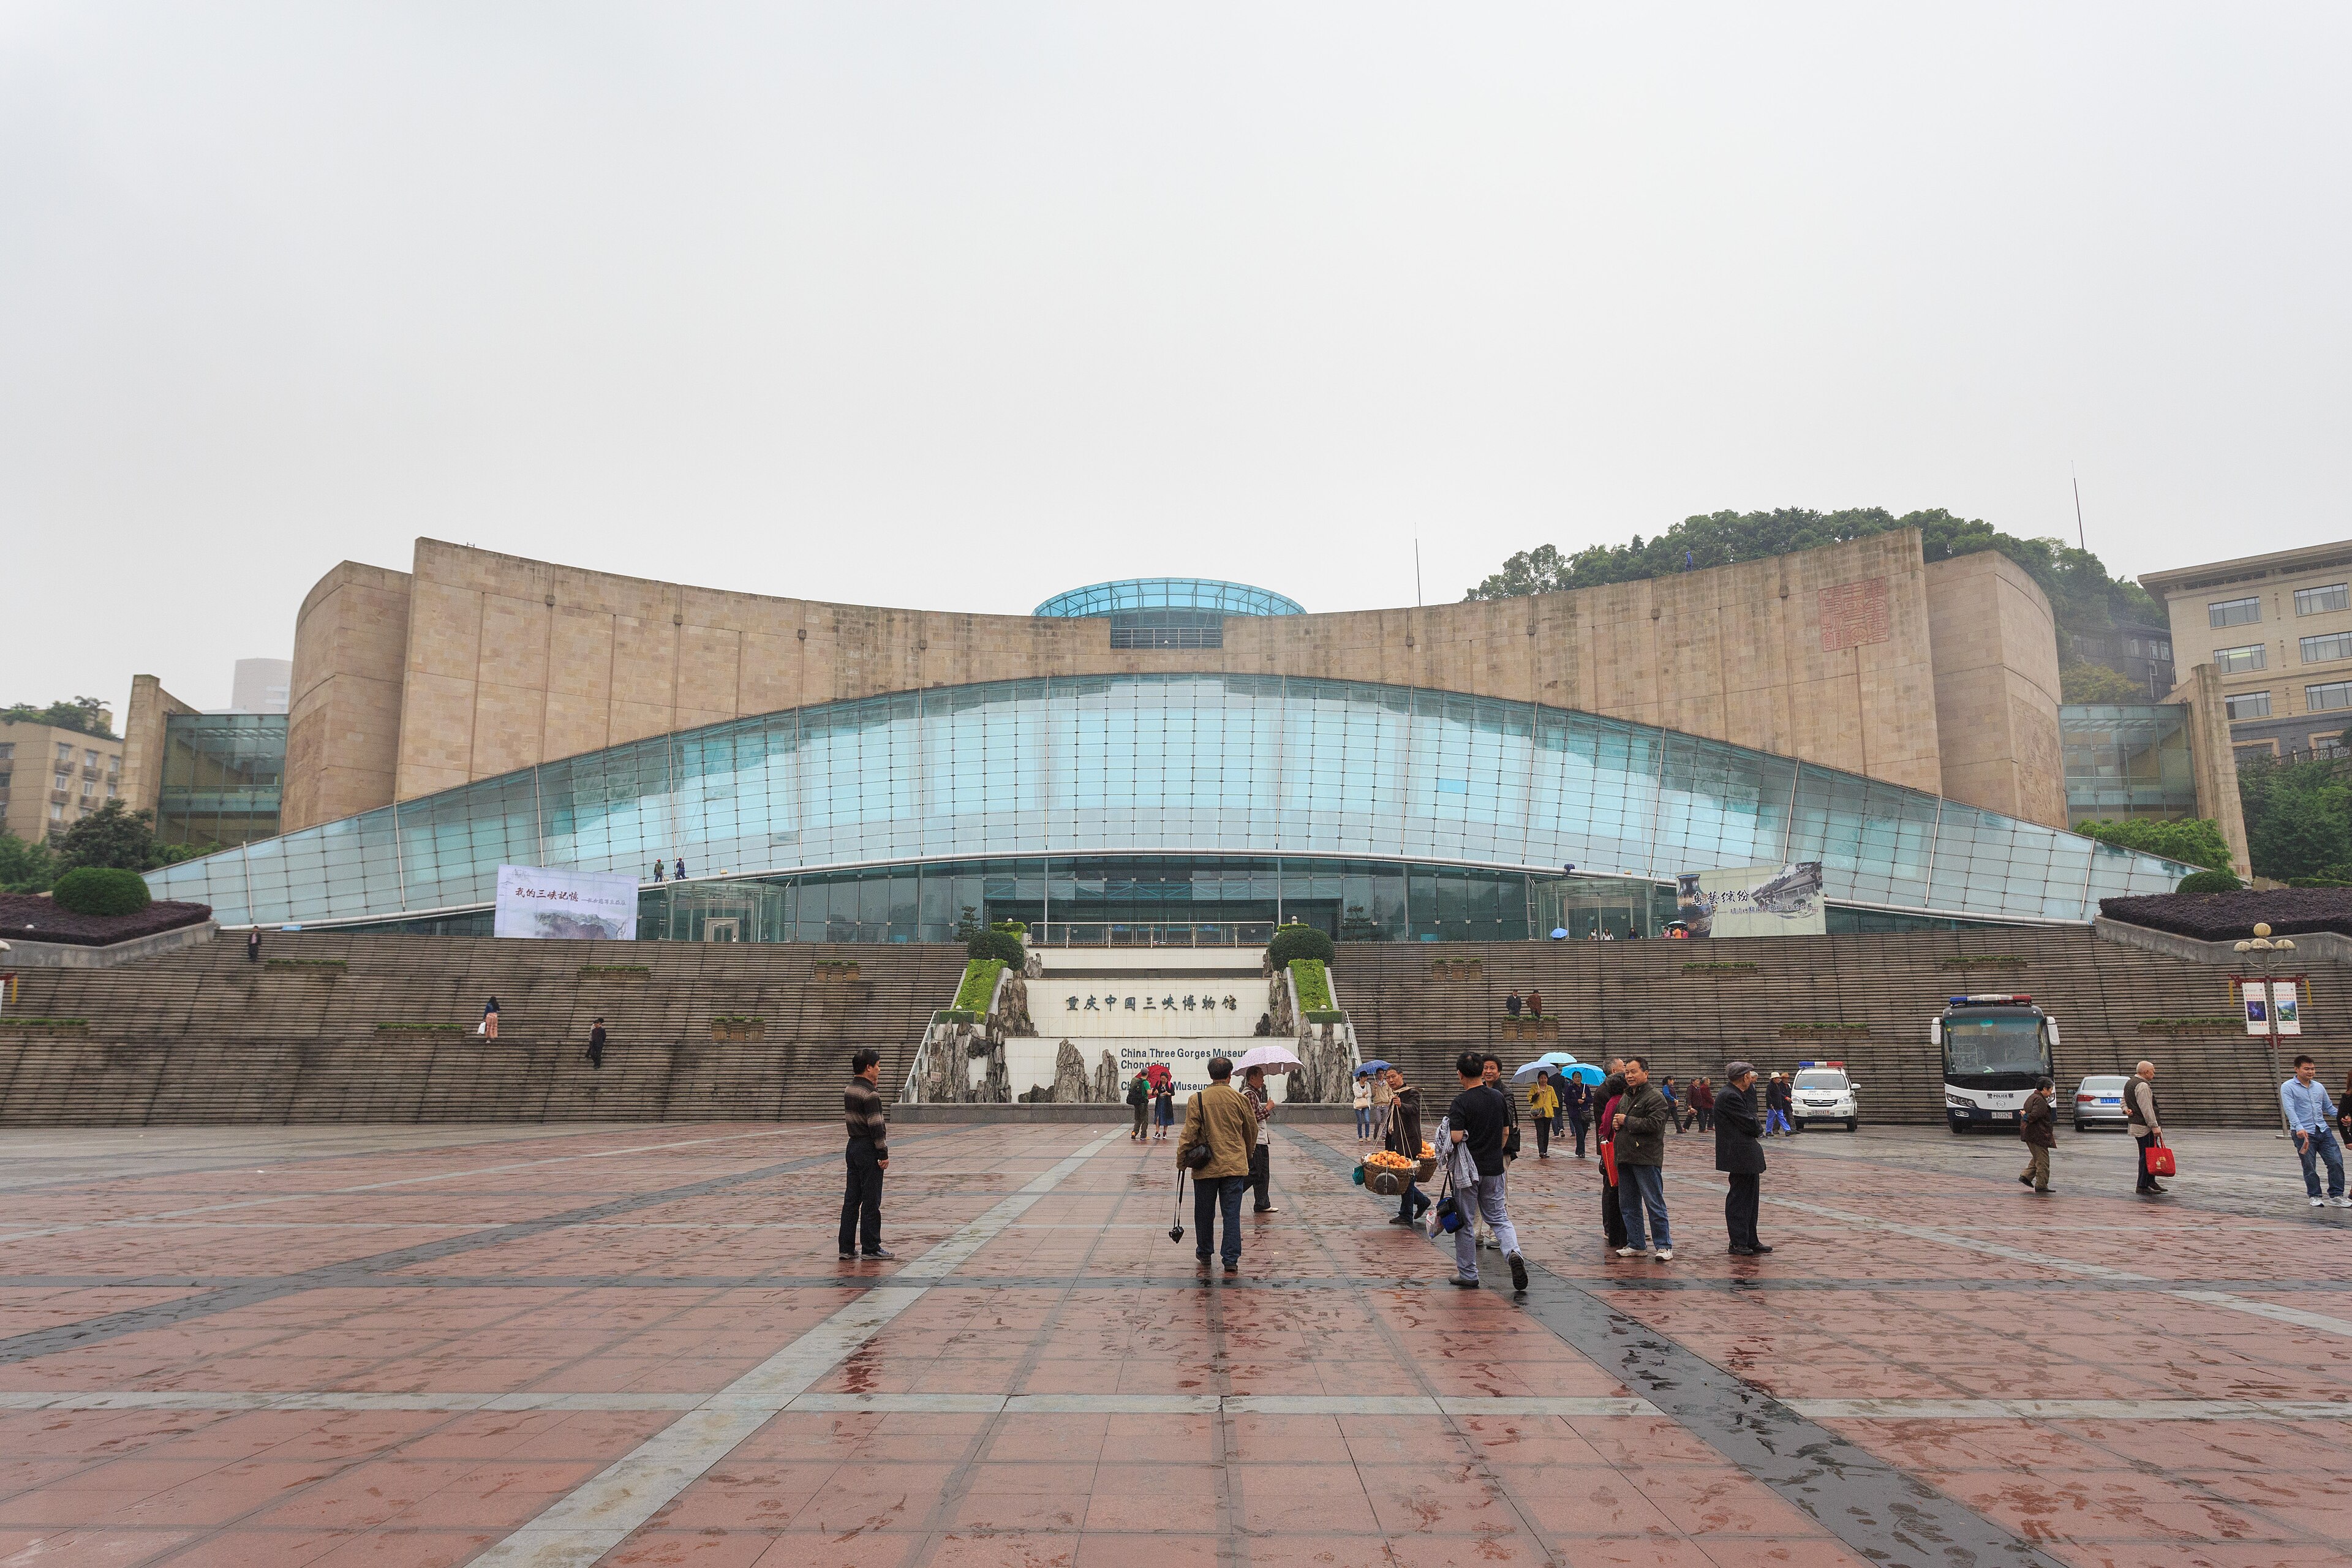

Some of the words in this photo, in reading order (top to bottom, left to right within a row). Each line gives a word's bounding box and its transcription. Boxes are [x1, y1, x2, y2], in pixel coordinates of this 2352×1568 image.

[1121, 1048, 1147, 1058] China
[1149, 1048, 1175, 1058] Three
[1177, 1048, 1211, 1060] Gorges
